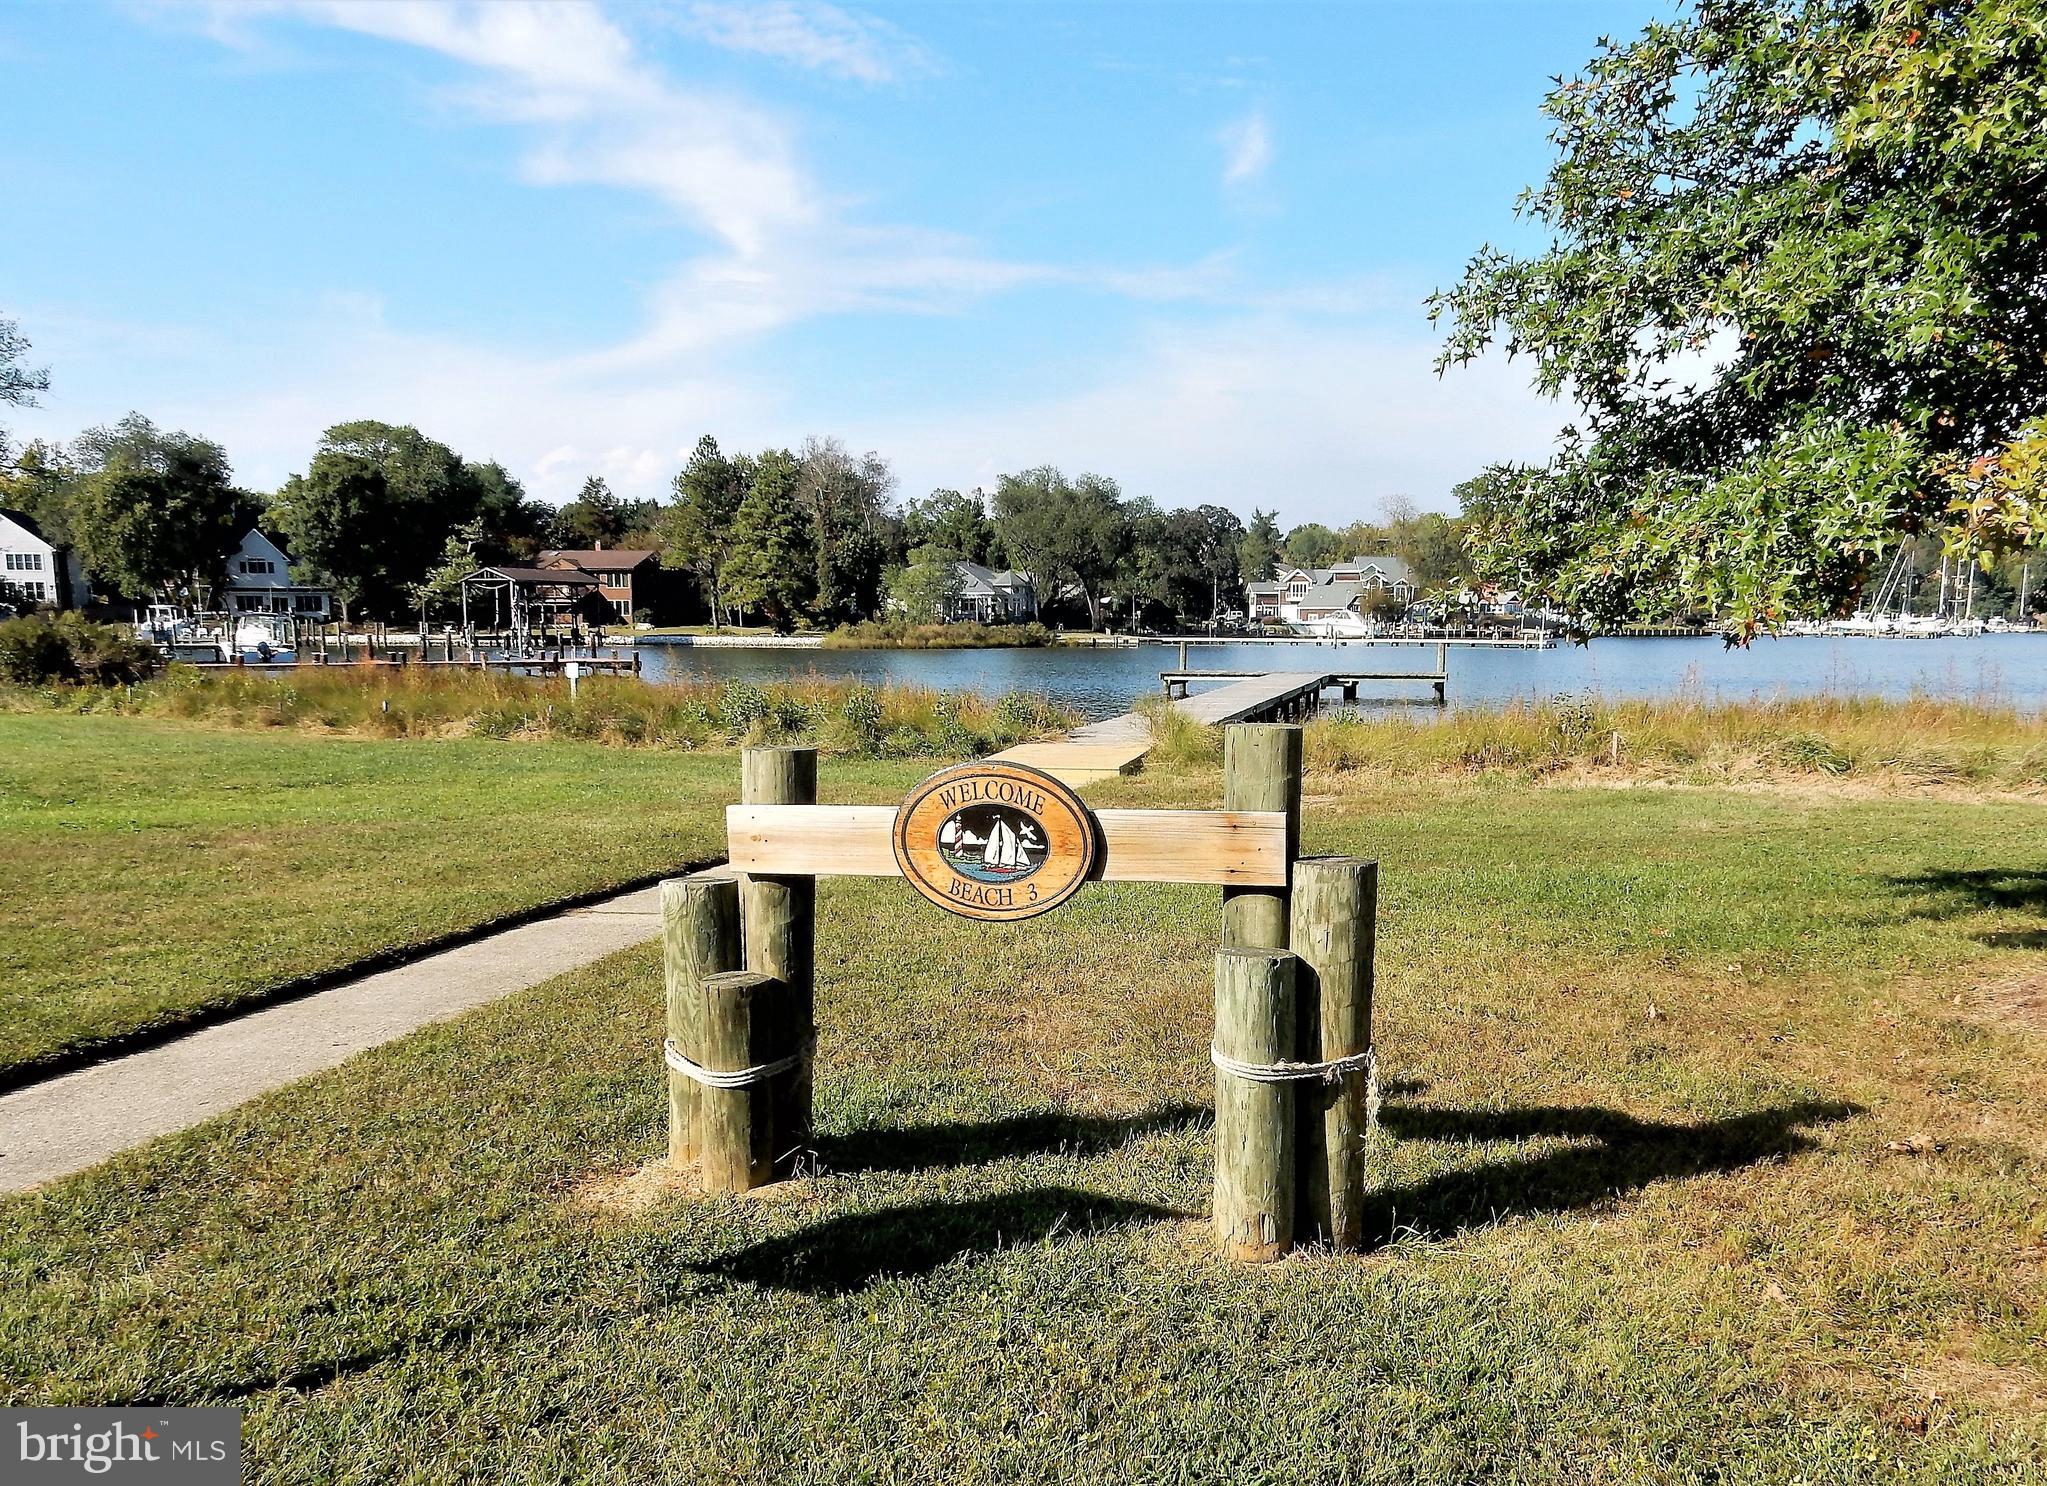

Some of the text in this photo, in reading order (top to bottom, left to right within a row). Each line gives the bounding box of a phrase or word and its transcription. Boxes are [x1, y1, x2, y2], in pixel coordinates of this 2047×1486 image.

[939, 780, 1046, 816] WELCOME
[948, 877, 1038, 907] BEACH 3
